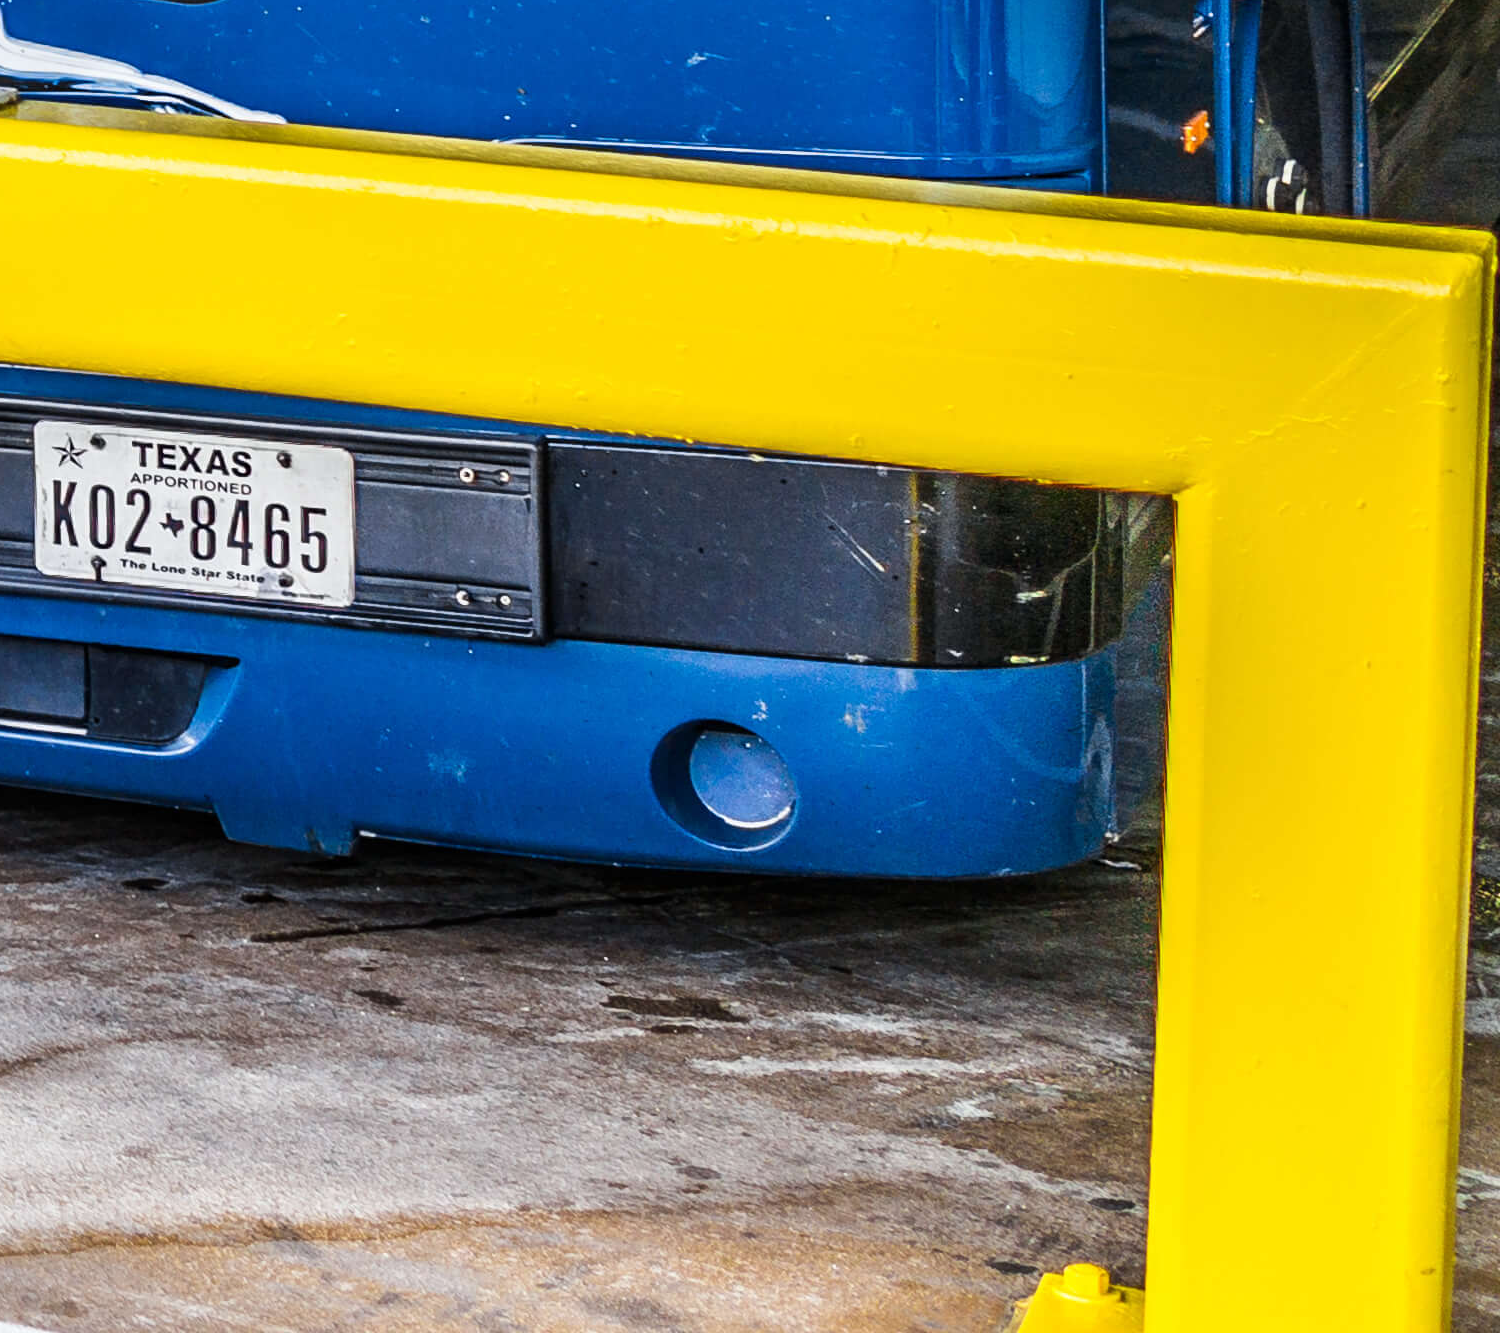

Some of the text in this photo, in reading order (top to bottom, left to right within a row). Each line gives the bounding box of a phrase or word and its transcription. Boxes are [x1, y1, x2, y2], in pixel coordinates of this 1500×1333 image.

[131, 440, 252, 478] TEXAS
[130, 472, 252, 496] APPORTIONED
[120, 558, 266, 584] The Lone Star State
